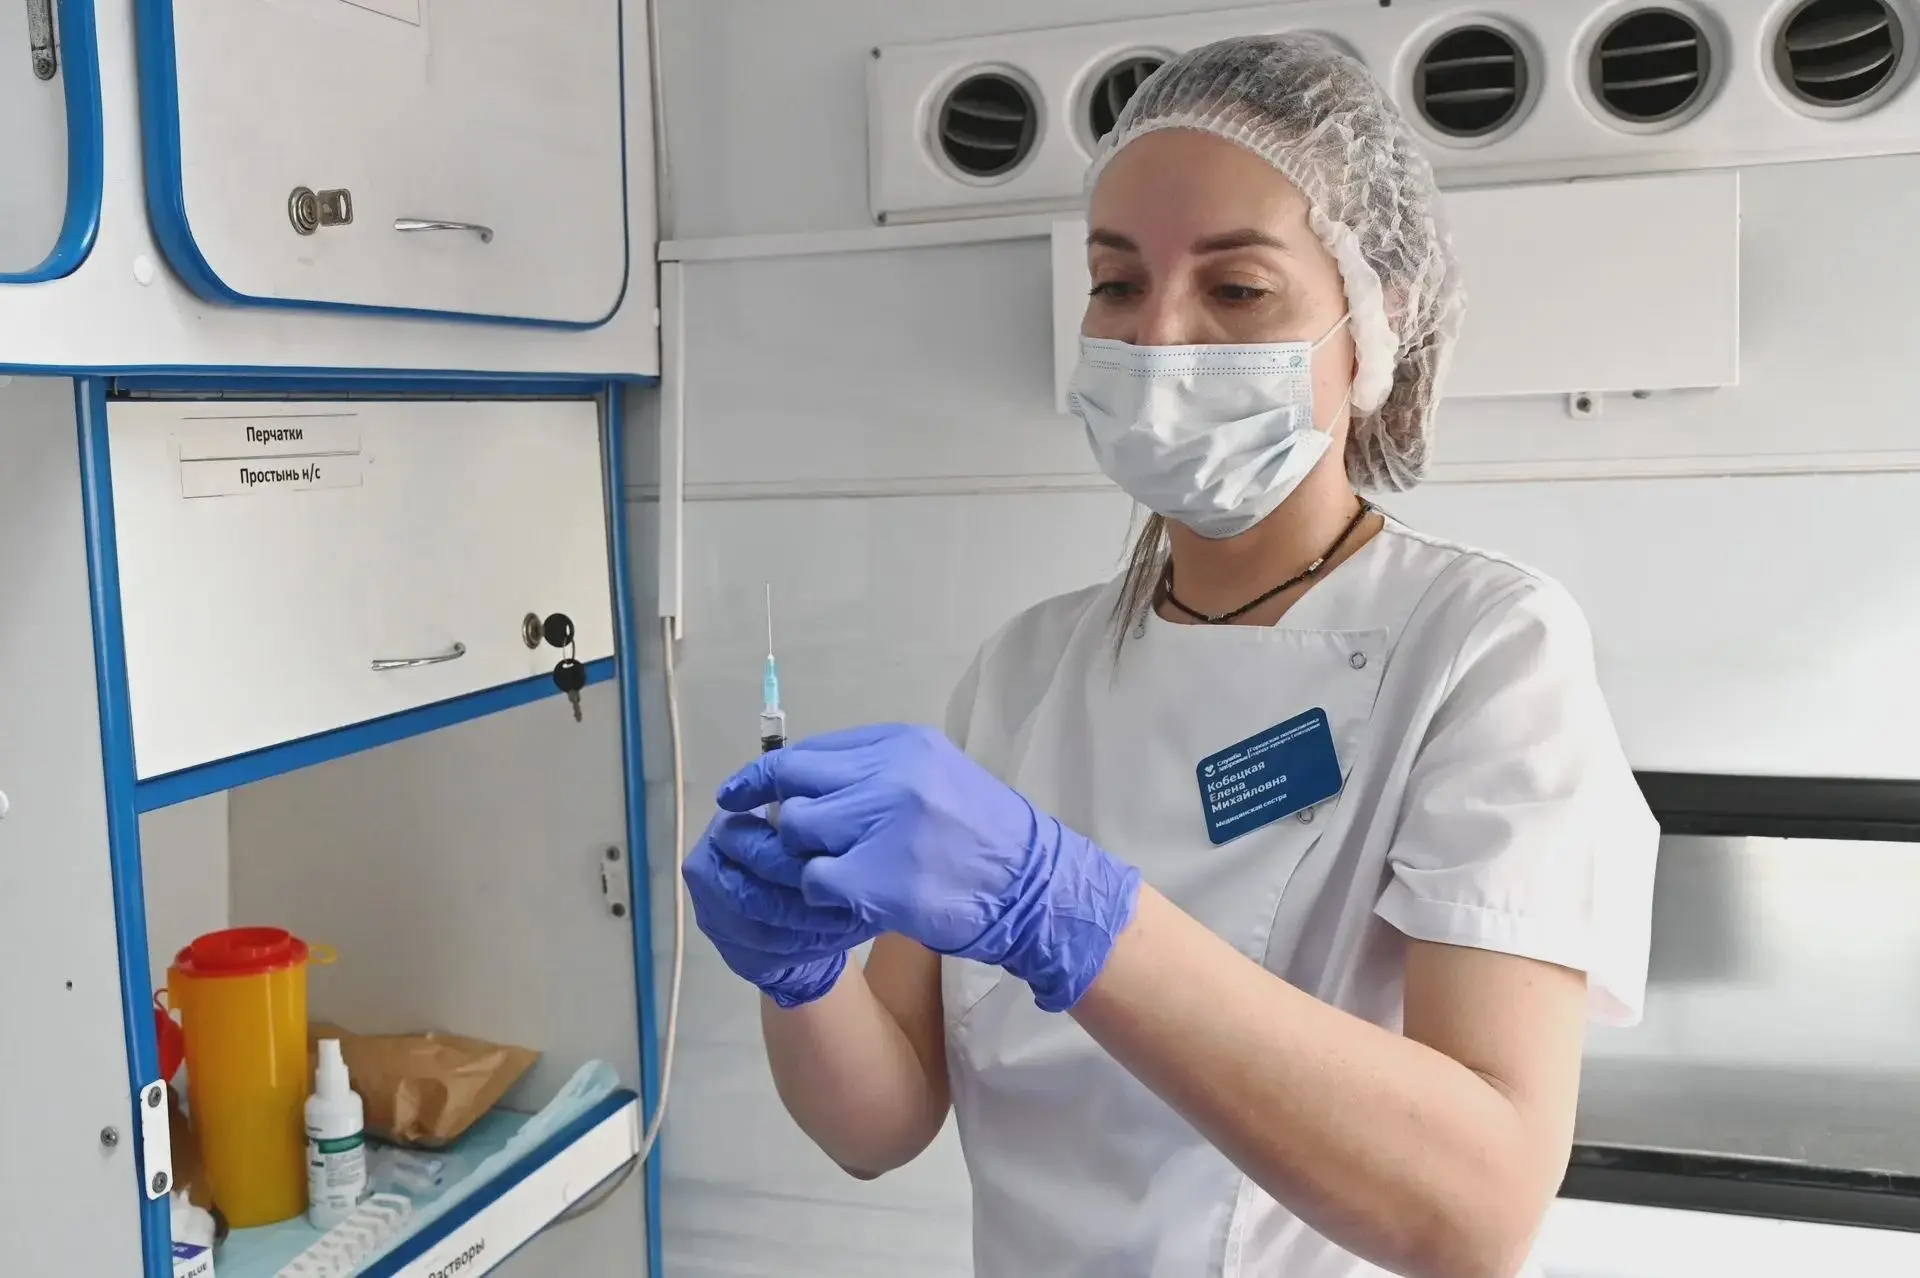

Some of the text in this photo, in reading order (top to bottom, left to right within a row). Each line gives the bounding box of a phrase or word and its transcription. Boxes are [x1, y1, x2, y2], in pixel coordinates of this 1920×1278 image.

[246, 427, 303, 445] Перчатки
[240, 463, 321, 487] Простынь н/с
[1207, 761, 1266, 792] Кобецкая
[1209, 782, 1246, 803] Елена
[1211, 774, 1287, 814] Михайловна
[1215, 794, 1288, 828] Медицинская сестра
